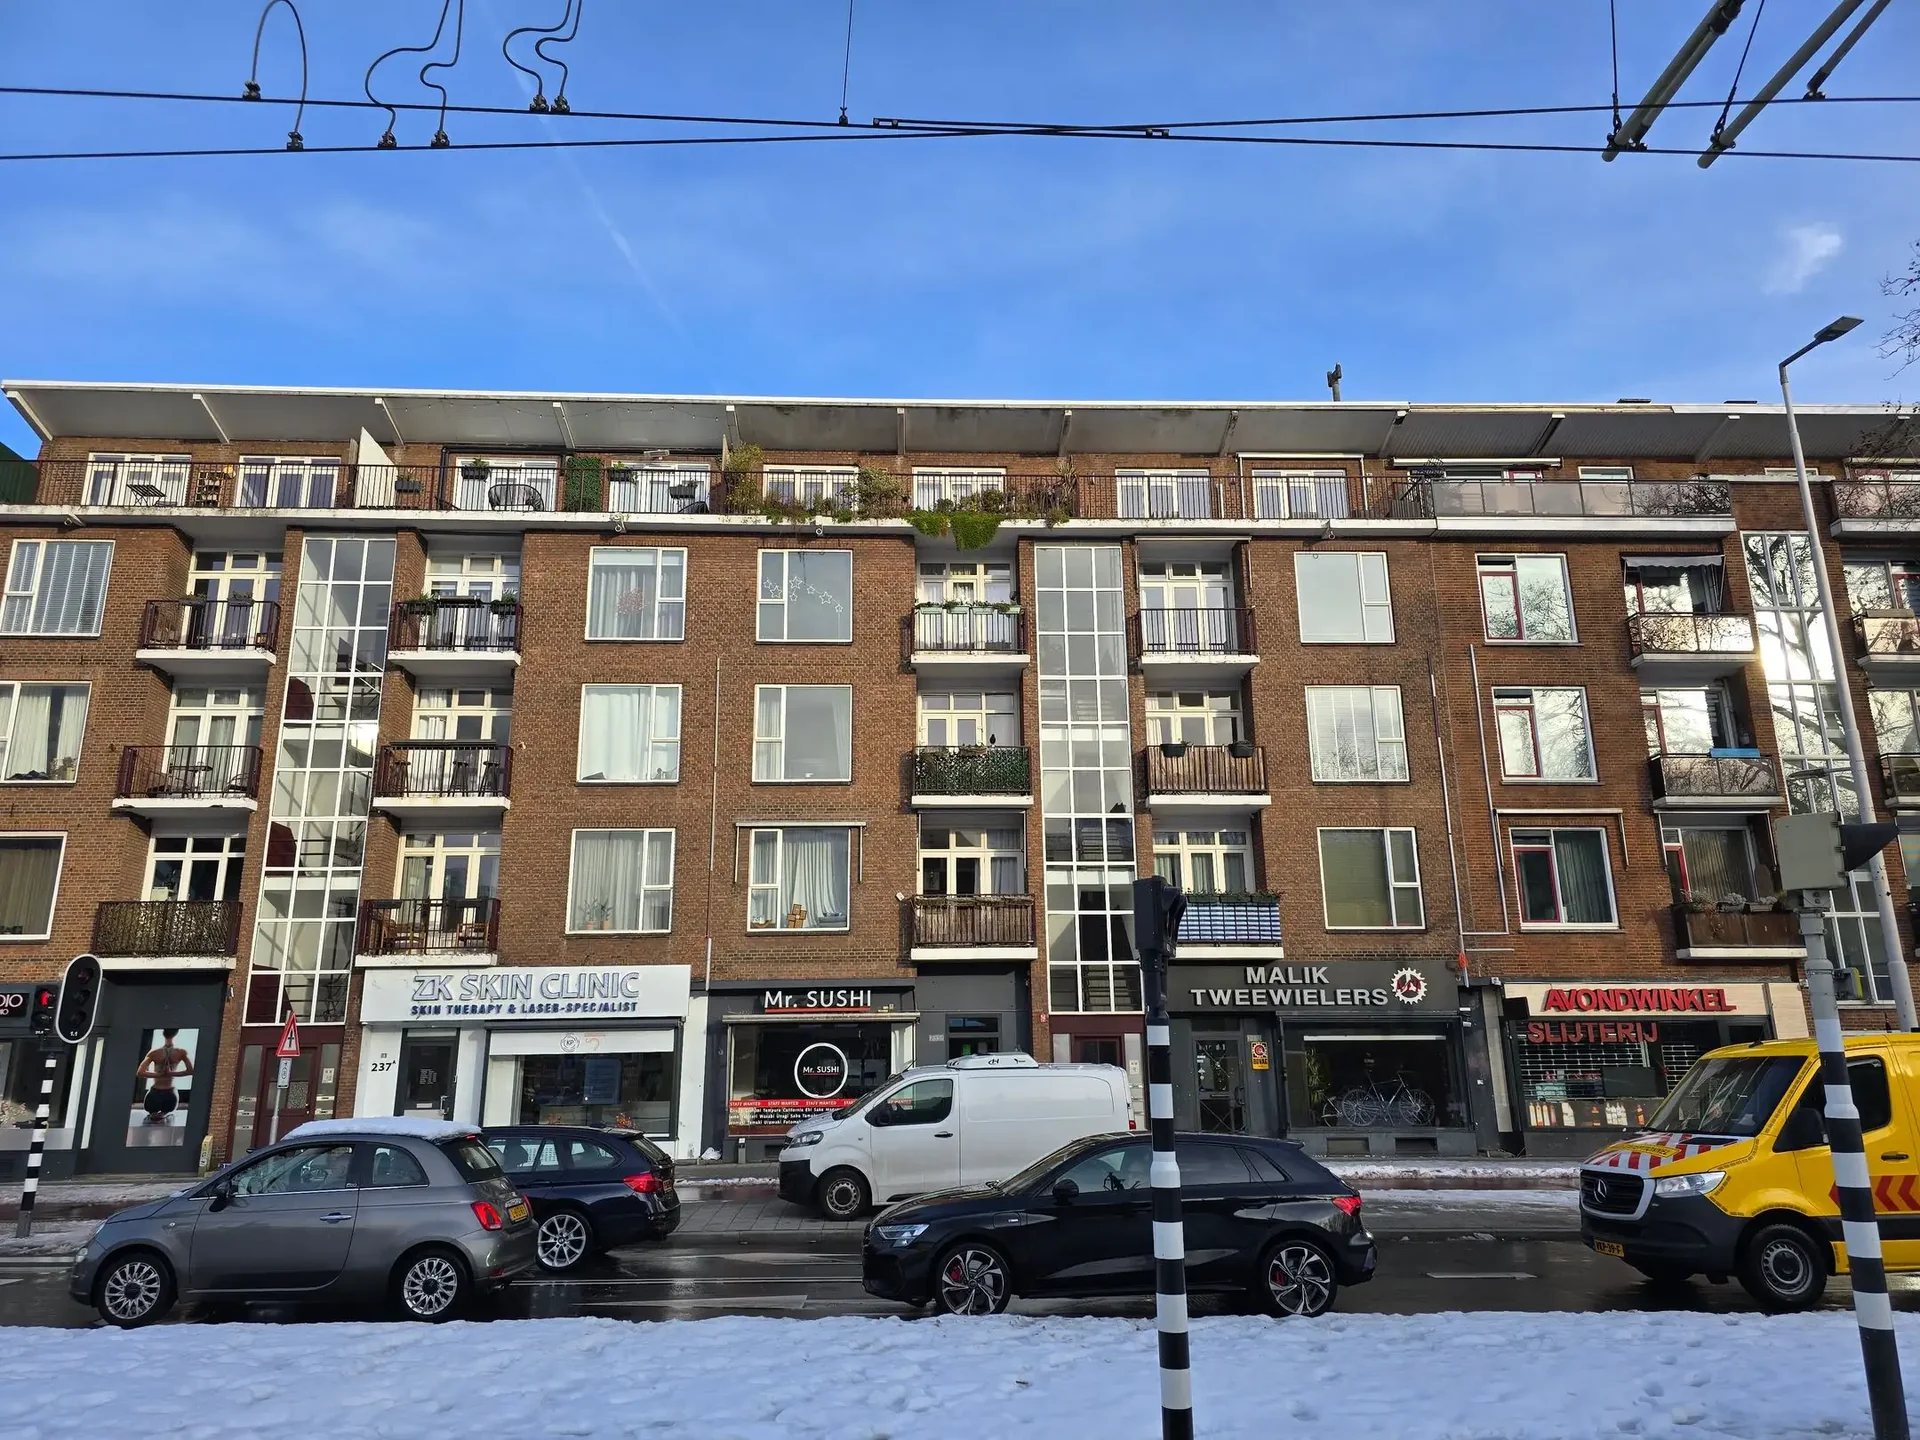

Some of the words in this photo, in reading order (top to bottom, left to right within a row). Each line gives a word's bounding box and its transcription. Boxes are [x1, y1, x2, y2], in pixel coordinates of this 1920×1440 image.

[1246, 966, 1330, 985] MALIK
[412, 975, 454, 1001] ZK
[460, 974, 533, 1001] SKIN
[540, 972, 639, 1000] CLINIC
[764, 990, 798, 1008] Mr.
[806, 989, 872, 1008] SUSHI
[1190, 988, 1389, 1006] TWEEWIELERS
[1542, 988, 1737, 1012] AVONDWINKEL
[411, 1005, 442, 1016] SKIN
[447, 1004, 503, 1015] THERAPY
[508, 1003, 517, 1014] &
[1527, 1021, 1659, 1043] SLIJTERIJ
[802, 1066, 815, 1074] Mr.
[816, 1065, 840, 1074] SUSHI
